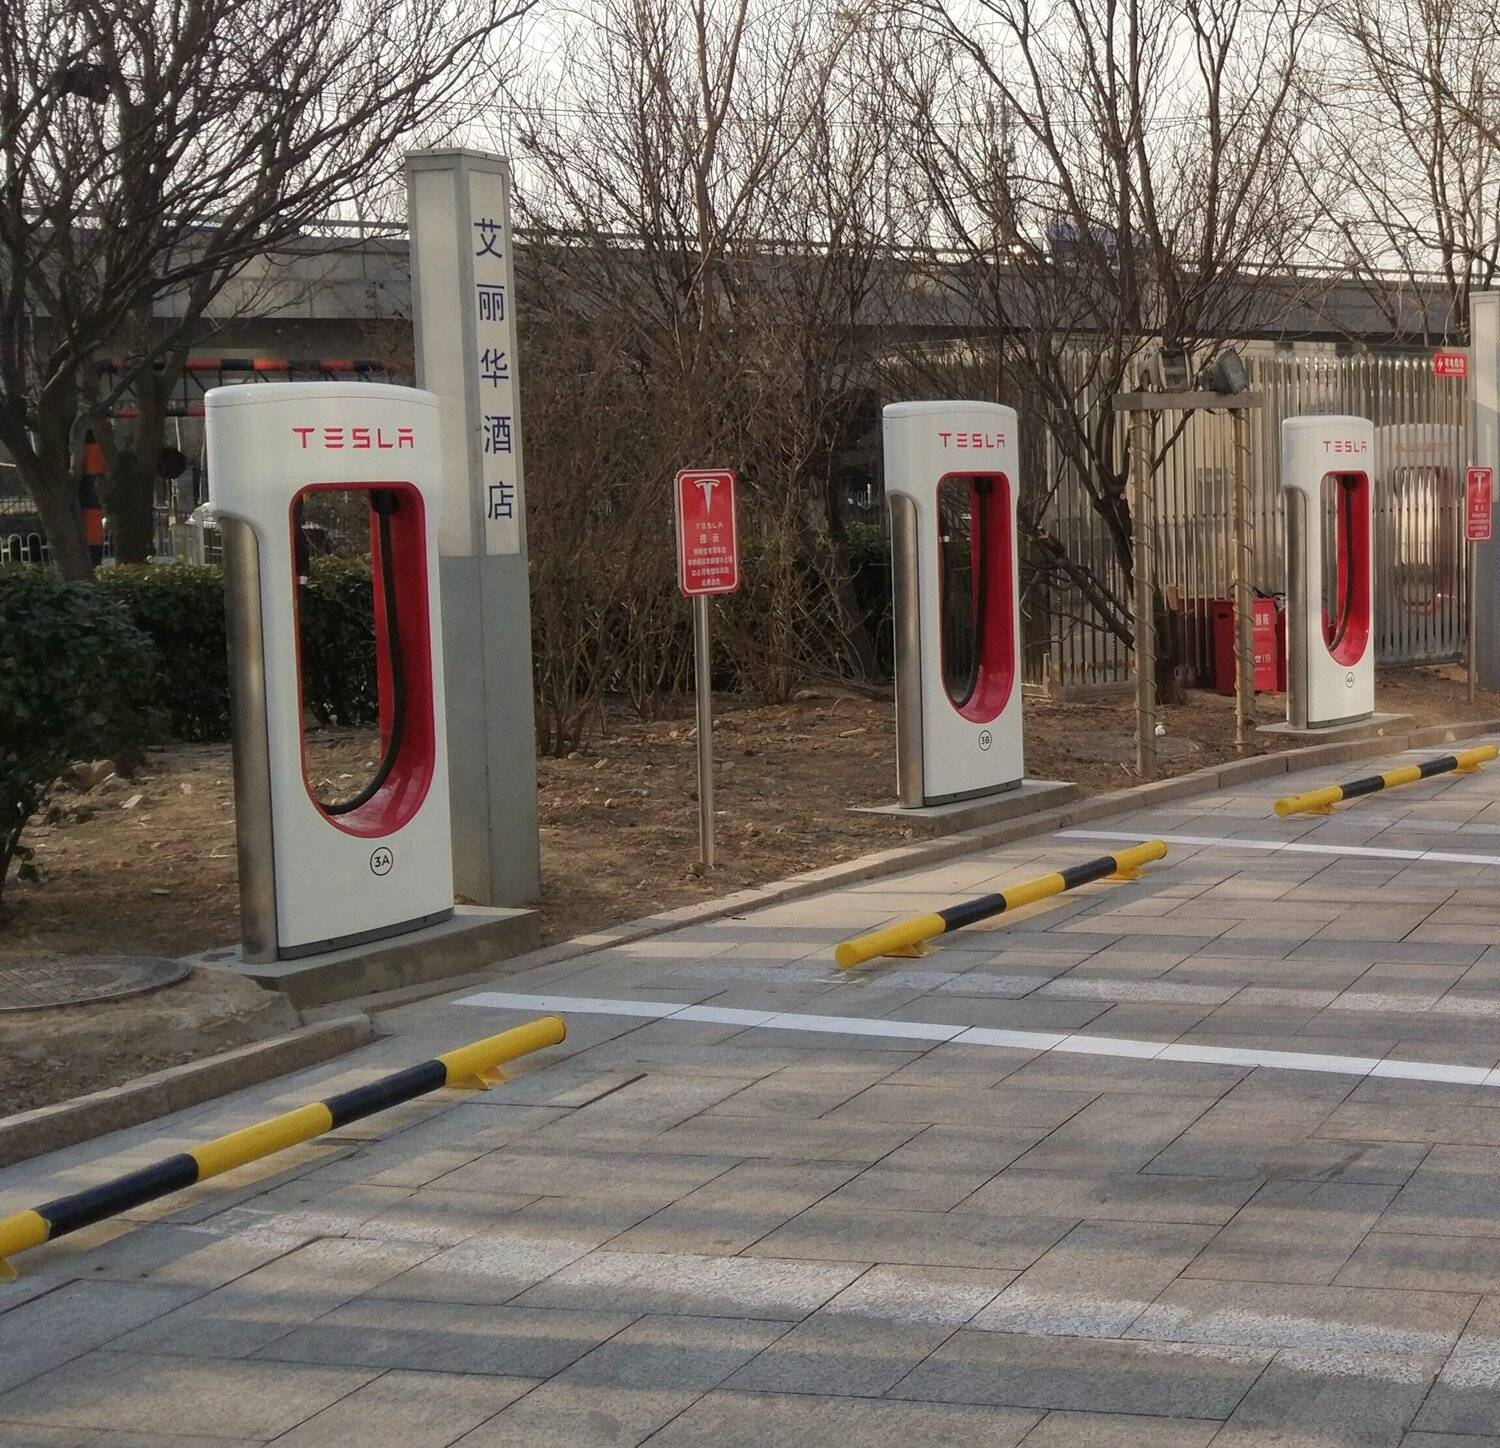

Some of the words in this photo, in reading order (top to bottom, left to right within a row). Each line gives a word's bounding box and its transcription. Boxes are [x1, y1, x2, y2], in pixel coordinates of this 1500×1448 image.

[474, 217, 514, 520] 艾丽华酒店
[292, 427, 414, 449] TESLA
[938, 431, 1006, 448] TESLA
[1322, 440, 1367, 453] TESLA
[374, 855, 390, 868] 3A
